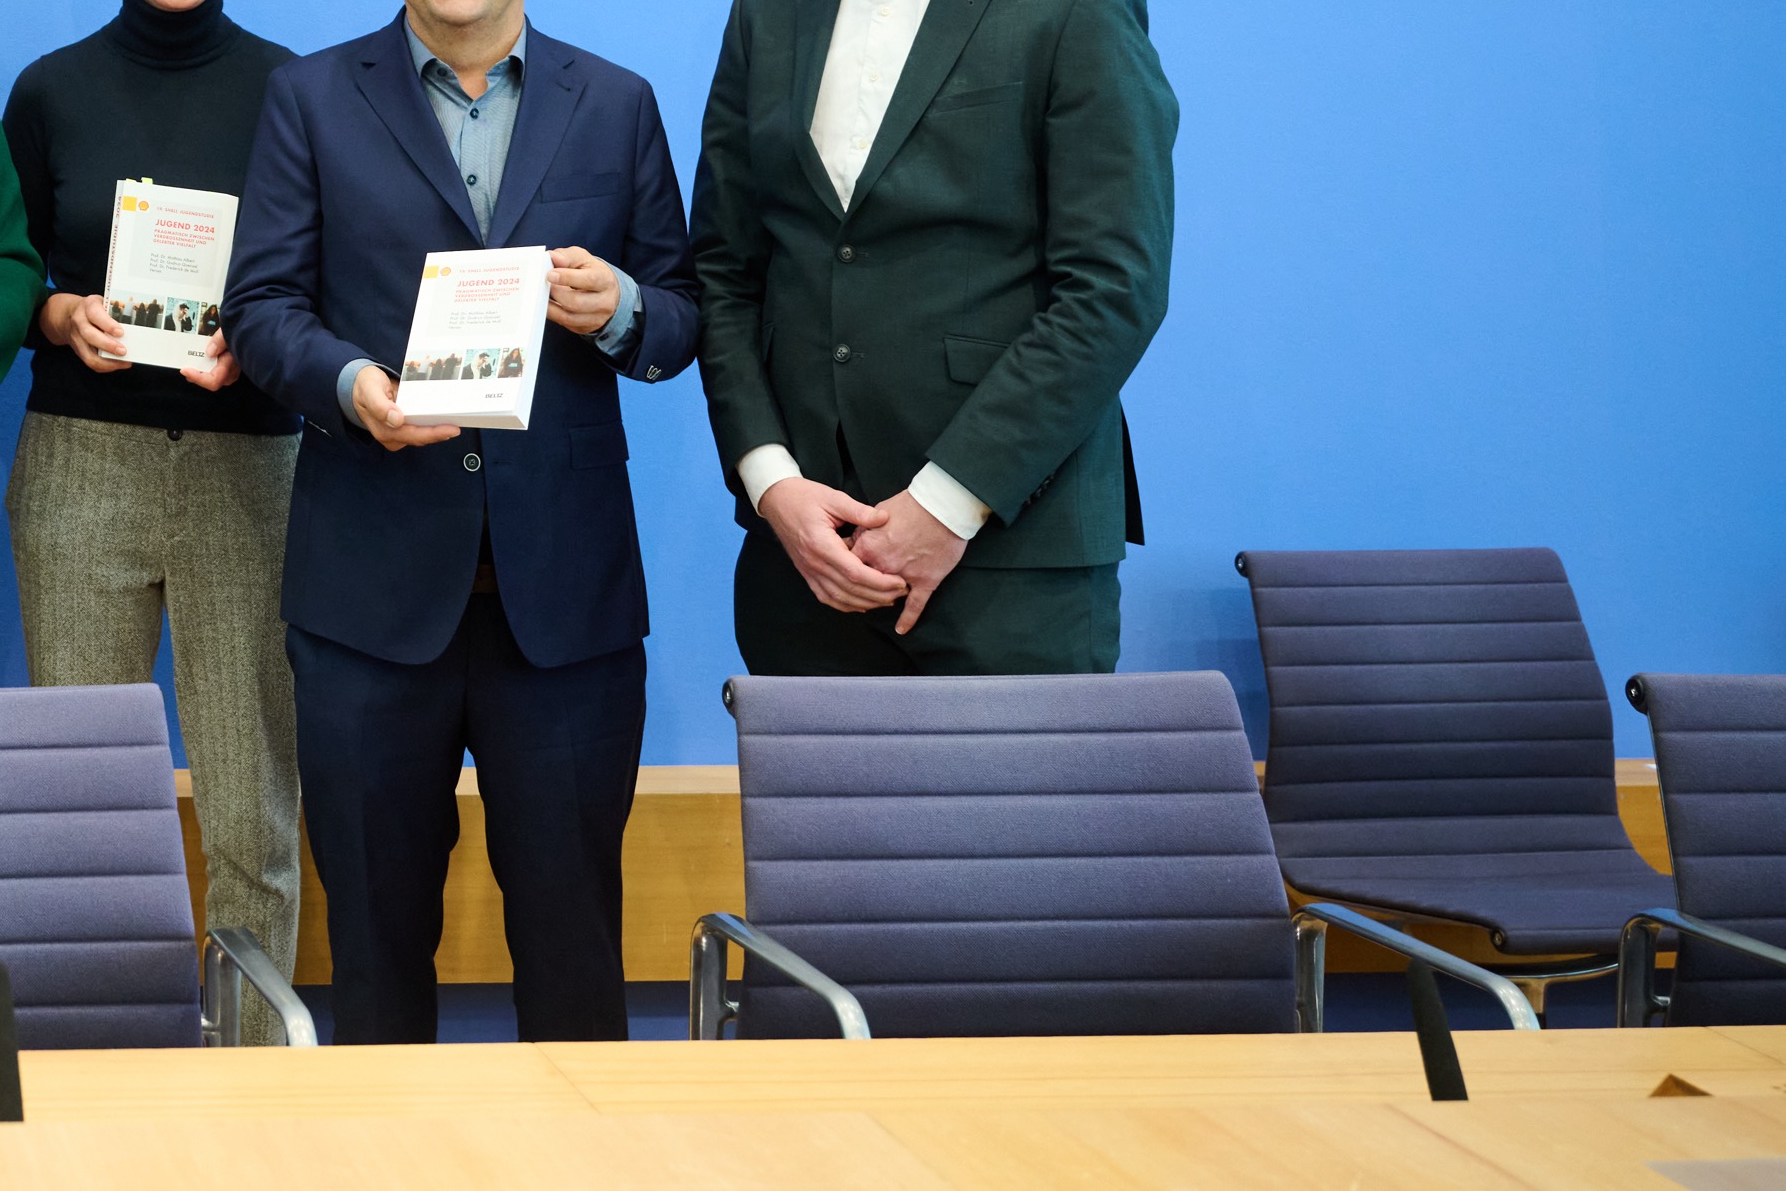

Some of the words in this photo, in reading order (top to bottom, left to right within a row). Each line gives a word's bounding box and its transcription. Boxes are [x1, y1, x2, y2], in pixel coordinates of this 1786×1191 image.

[155, 219, 191, 230] JUGEND
[194, 224, 215, 234] 2024
[154, 229, 188, 237] PRAGMATISCH
[189, 233, 215, 241] ZWISCHEN
[187, 350, 205, 358] BELTZ
